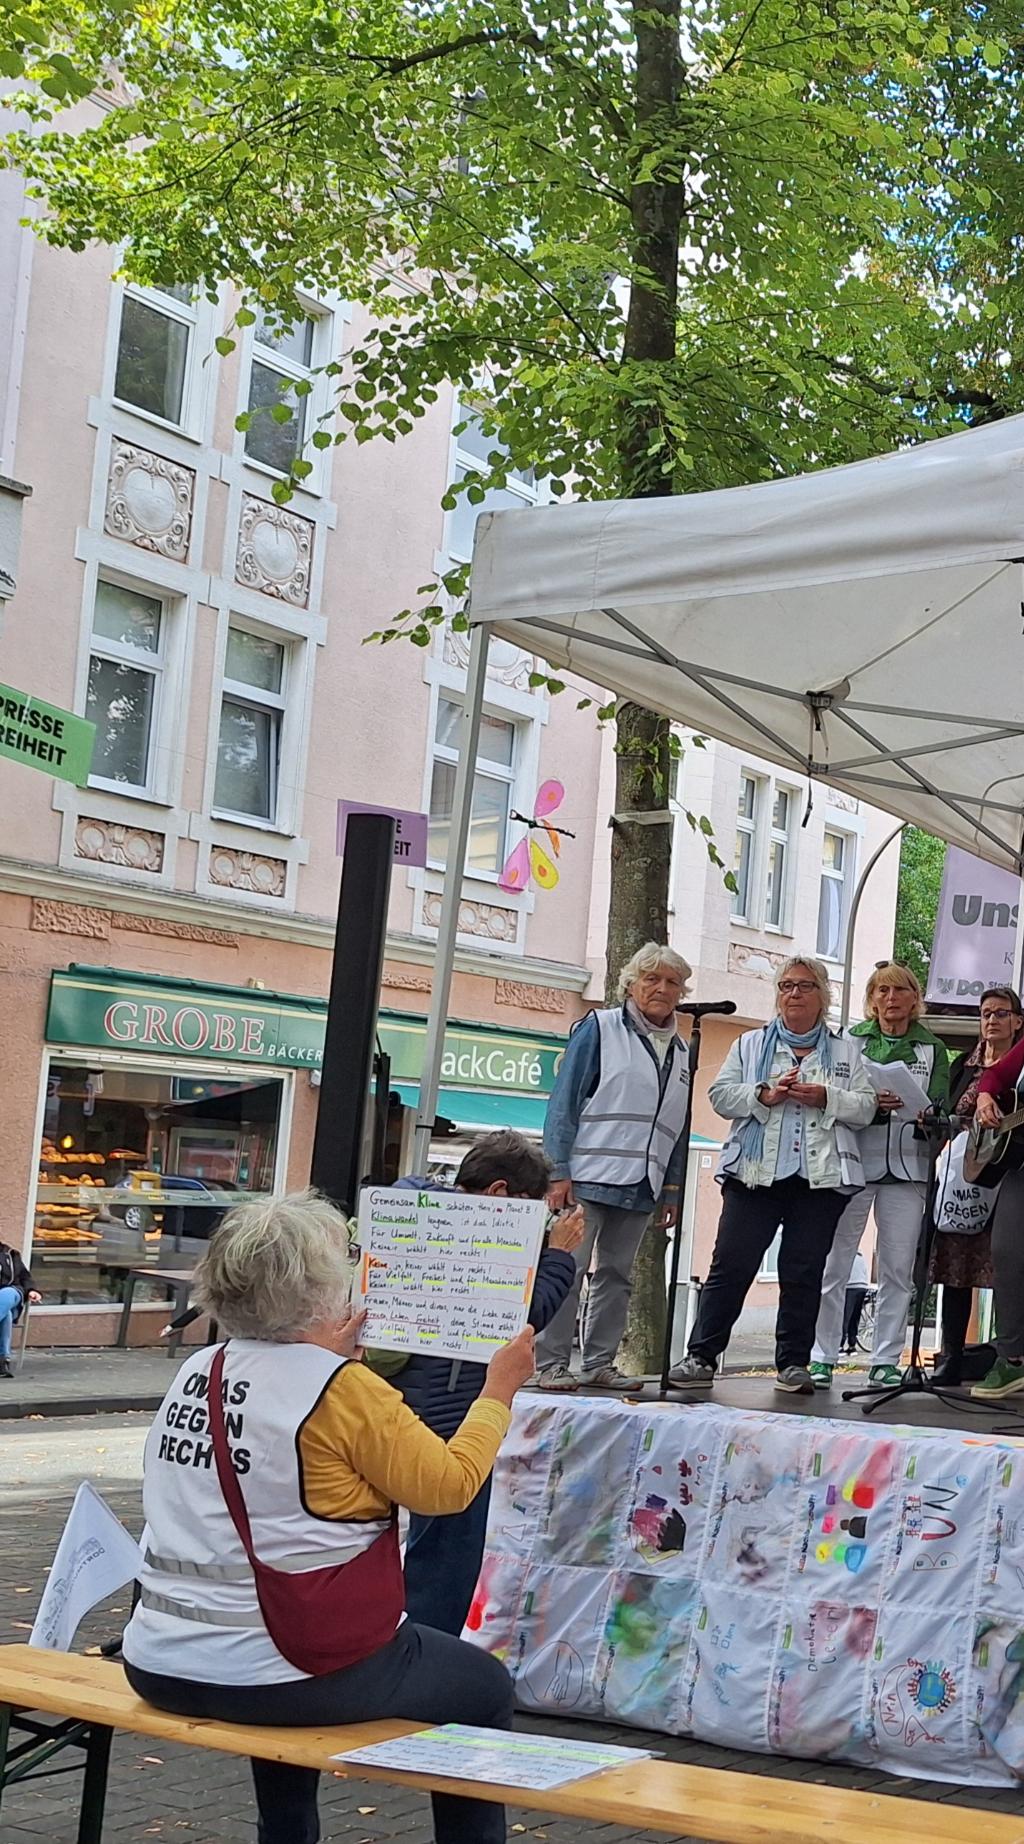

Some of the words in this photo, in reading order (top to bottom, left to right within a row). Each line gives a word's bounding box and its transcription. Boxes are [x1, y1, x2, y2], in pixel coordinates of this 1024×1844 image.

[0, 725, 67, 766] EIHEIT
[104, 1001, 264, 1056] GROBE
[267, 1042, 323, 1062] BÄCKER
[440, 1045, 542, 1086] ackCafé
[943, 1201, 990, 1219] GEGEN
[166, 1402, 243, 1439] GEGN
[158, 1434, 251, 1475] RECHS
[881, 1692, 899, 1723] Nein
